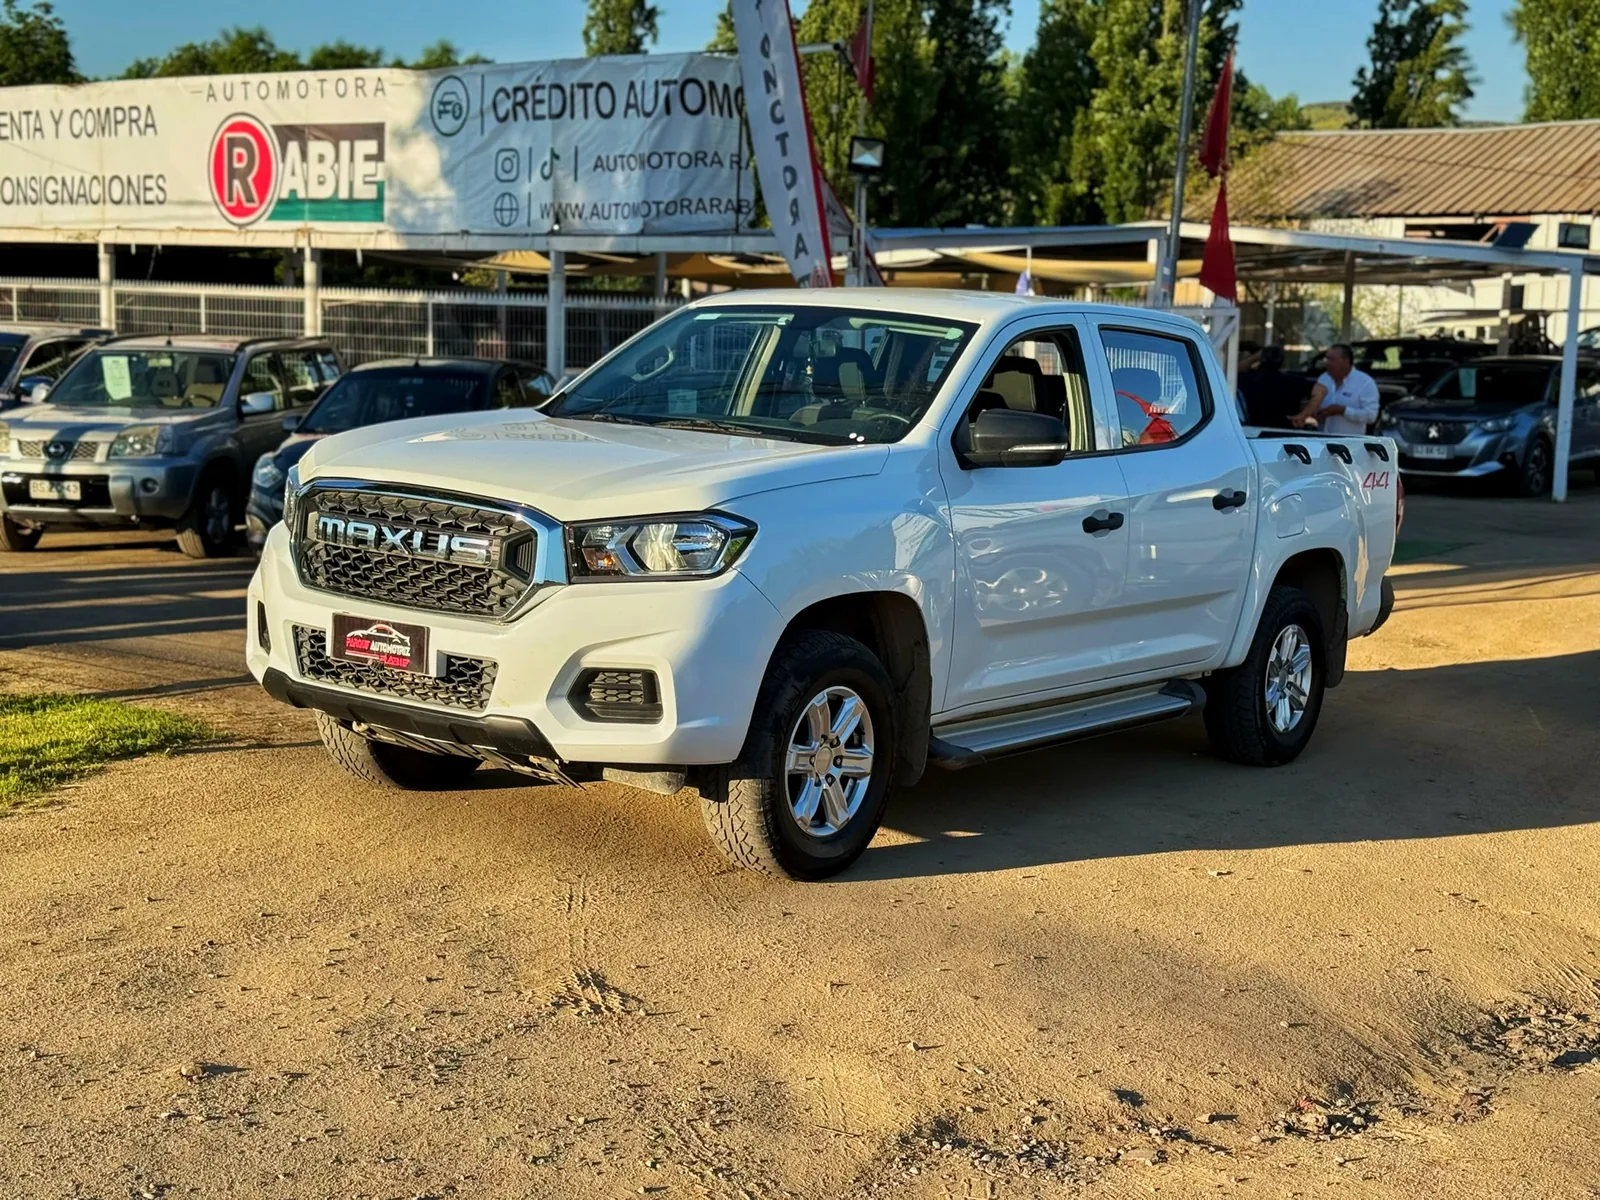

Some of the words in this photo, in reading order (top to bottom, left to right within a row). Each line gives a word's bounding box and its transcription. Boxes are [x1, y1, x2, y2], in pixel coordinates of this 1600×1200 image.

[206, 76, 386, 102] AUTOMOTORA
[492, 75, 616, 123] CRÉDITO
[49, 109, 64, 139] Y
[69, 104, 158, 138] COMPRA
[224, 132, 379, 207] RABIE
[592, 150, 724, 173] AUTOMOTORA
[317, 515, 493, 566] MAXUS
[369, 639, 412, 657] AUTOMOTRIZ
